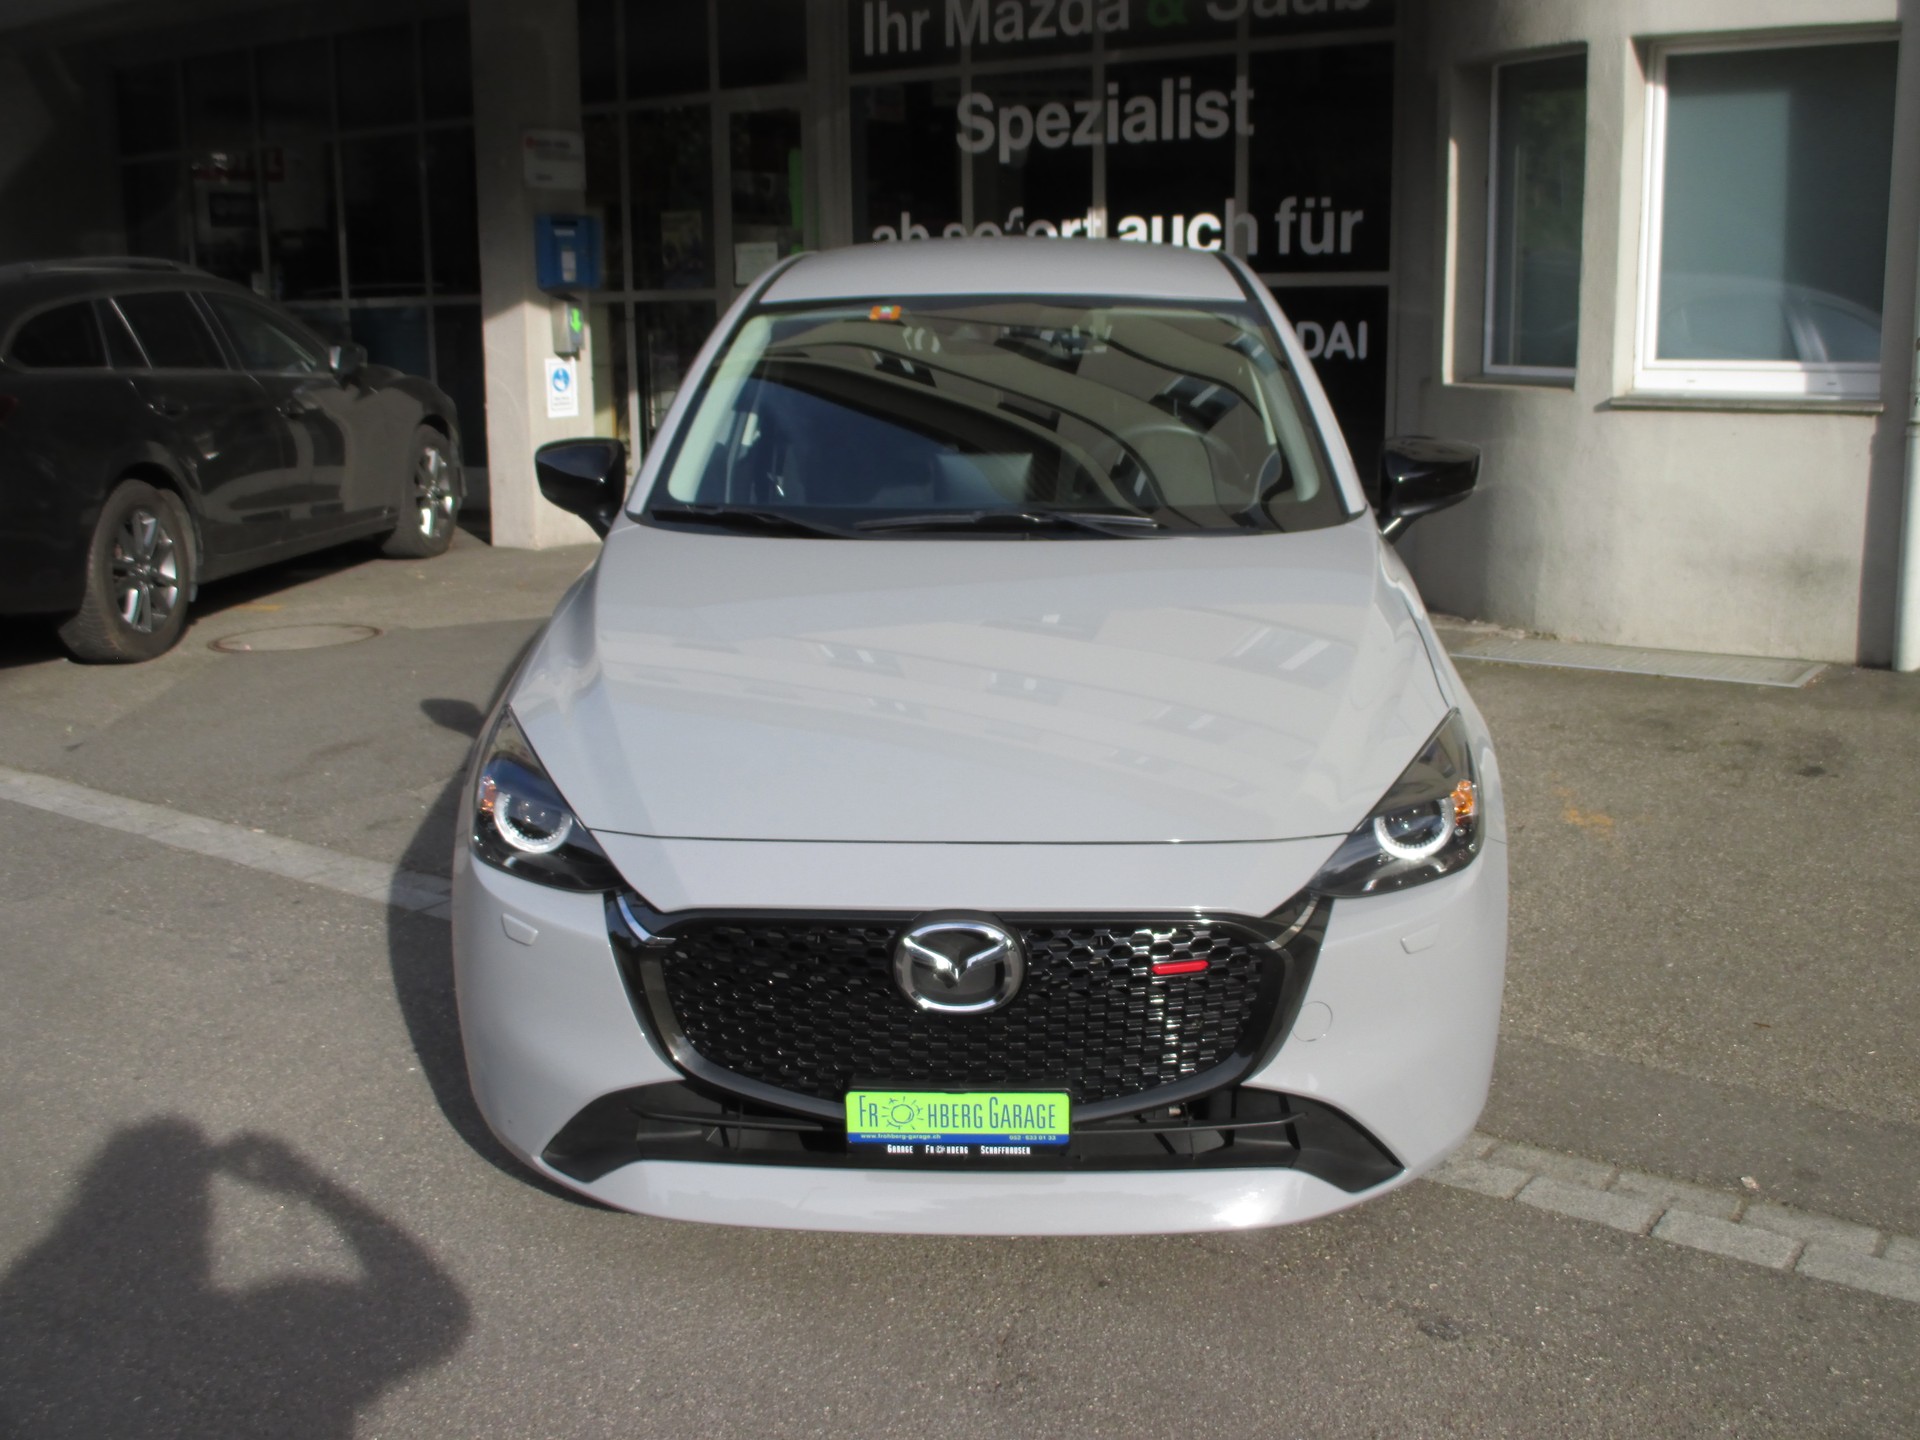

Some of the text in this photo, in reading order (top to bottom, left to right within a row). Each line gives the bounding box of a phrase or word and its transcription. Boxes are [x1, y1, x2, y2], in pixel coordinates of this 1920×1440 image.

[864, 1, 930, 56] Ihr
[945, 0, 1129, 47] Mazda
[956, 76, 1254, 164] Spezialist
[1117, 198, 1258, 255] auch
[1274, 197, 1363, 255] für
[989, 1096, 1056, 1129] GARAGE
